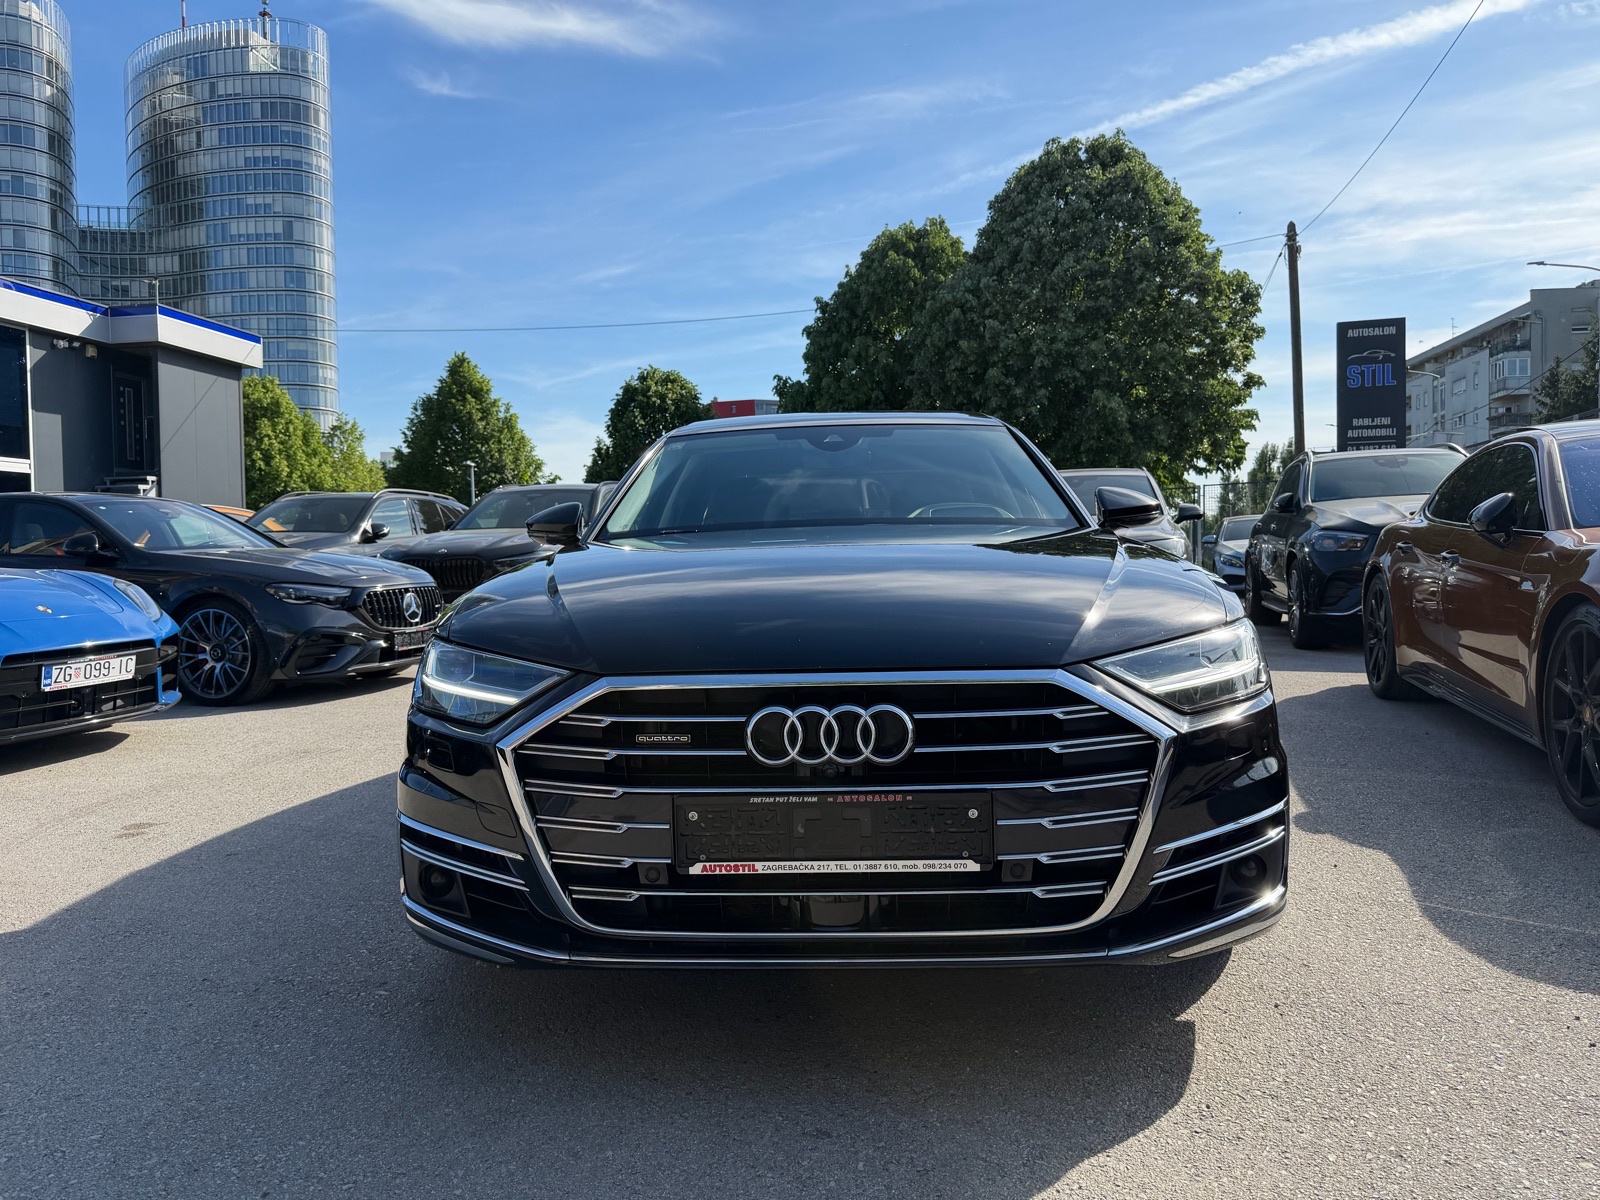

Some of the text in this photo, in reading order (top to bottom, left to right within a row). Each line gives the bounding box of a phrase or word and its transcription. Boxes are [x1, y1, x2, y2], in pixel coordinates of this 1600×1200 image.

[1347, 326, 1397, 337] AUTOSALON
[1346, 363, 1397, 388] STIL
[1352, 417, 1391, 426] RABLJENI
[1347, 428, 1397, 438] AUTOMOBILI
[53, 666, 73, 684] ZG
[836, 794, 903, 802] AUTOSALON
[700, 863, 759, 873] AUTOSTIL
[761, 862, 815, 872] ZAGREBAČKA
[816, 863, 833, 872] 217,
[834, 863, 851, 871] TEL.
[852, 863, 882, 871] 01/3887
[884, 862, 900, 872] 610,
[901, 862, 921, 871] mob.
[953, 862, 968, 870] 070
